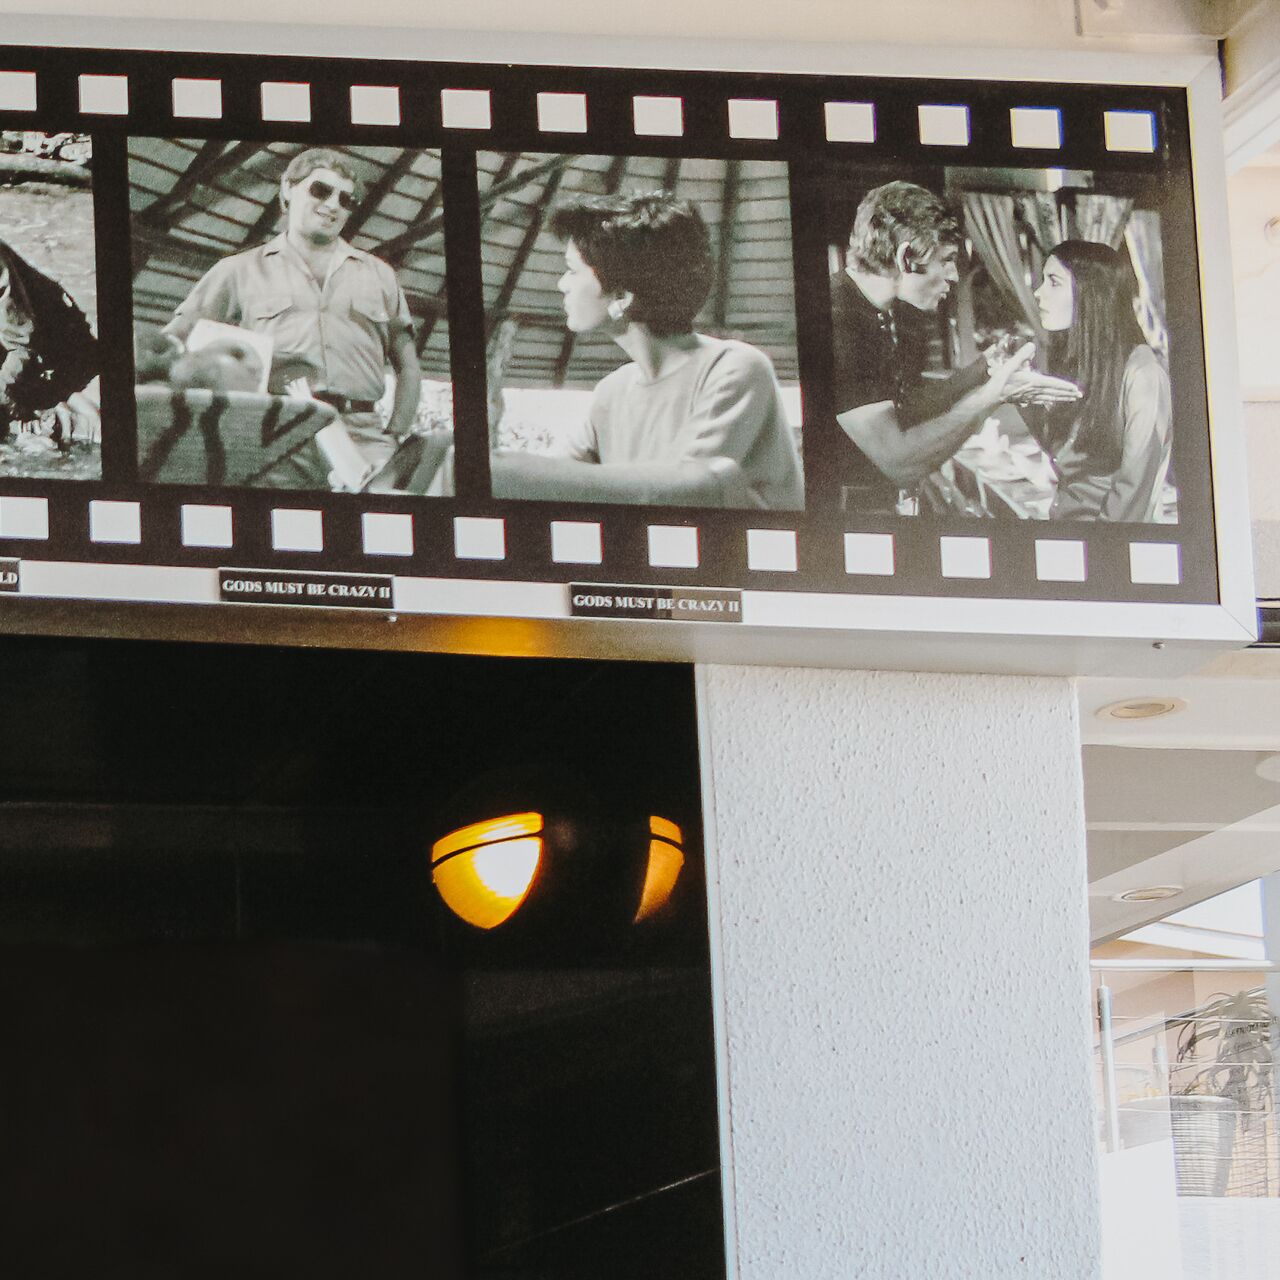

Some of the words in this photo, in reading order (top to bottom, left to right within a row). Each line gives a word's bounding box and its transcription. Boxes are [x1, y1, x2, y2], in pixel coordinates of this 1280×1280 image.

[222, 579, 262, 593] GODS
[264, 581, 305, 595] MUST
[307, 583, 326, 596] BE
[327, 584, 378, 598] CRAZY
[379, 586, 390, 599] II
[573, 594, 613, 608] GODS
[614, 596, 655, 609] MUST
[657, 598, 676, 610] BE
[678, 599, 727, 612] CRAZY
[728, 600, 739, 612] II
